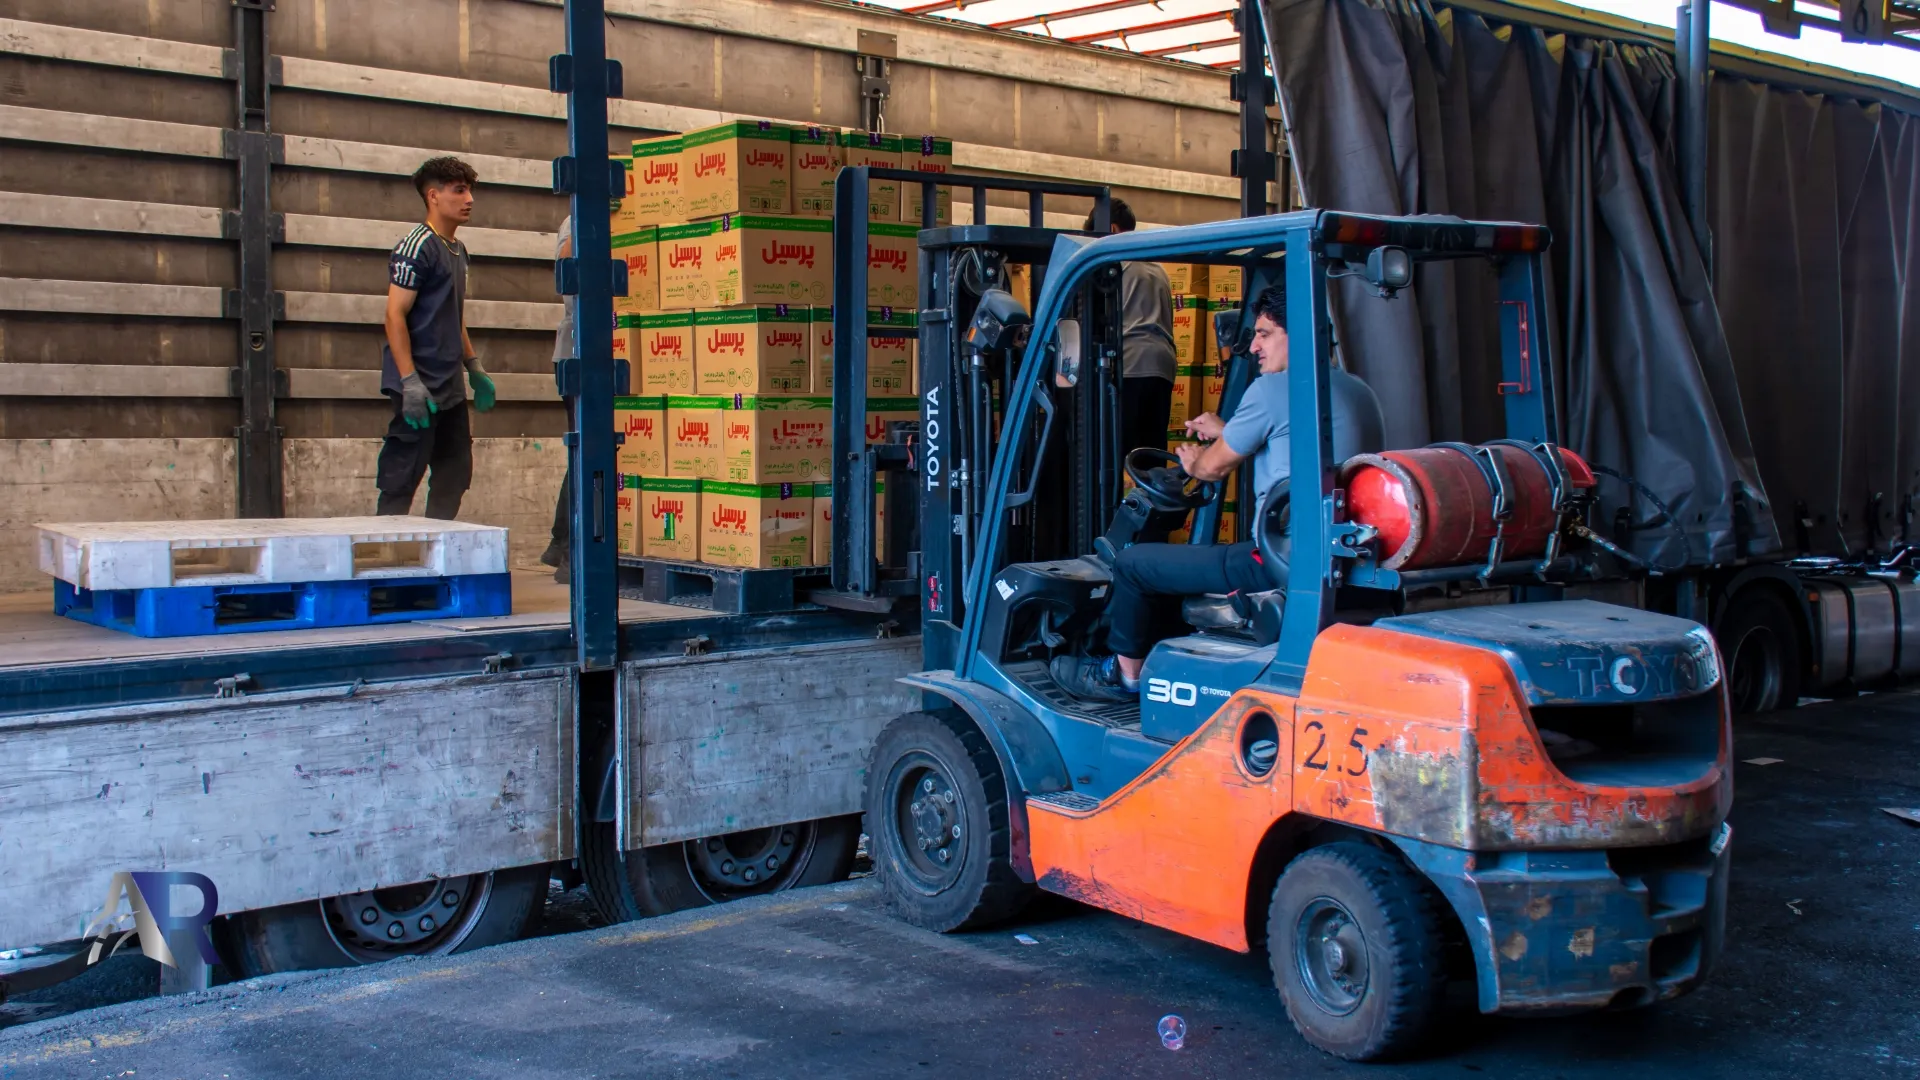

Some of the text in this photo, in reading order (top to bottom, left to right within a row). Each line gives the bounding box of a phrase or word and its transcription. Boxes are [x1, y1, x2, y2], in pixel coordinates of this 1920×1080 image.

[695, 153, 726, 177] پرسیل
[746, 149, 784, 170] پرسیل
[644, 160, 679, 186] پرسیل
[670, 244, 702, 269] پرسیل
[716, 245, 737, 262] پرسیل
[762, 239, 815, 269] پرسیل
[612, 334, 626, 357] پرس
[651, 332, 682, 359] پرسیل
[708, 329, 745, 356] پرسیل
[767, 330, 803, 351] پرسیل
[624, 414, 653, 440] پرسیل
[678, 418, 709, 445] پرسیل
[728, 422, 750, 441] پرسیل
[927, 387, 939, 491] TOYOTA
[713, 504, 747, 534] پرسیل
[1147, 678, 1232, 707] 30 TOYOTA
[1303, 721, 1369, 776] 2.5
